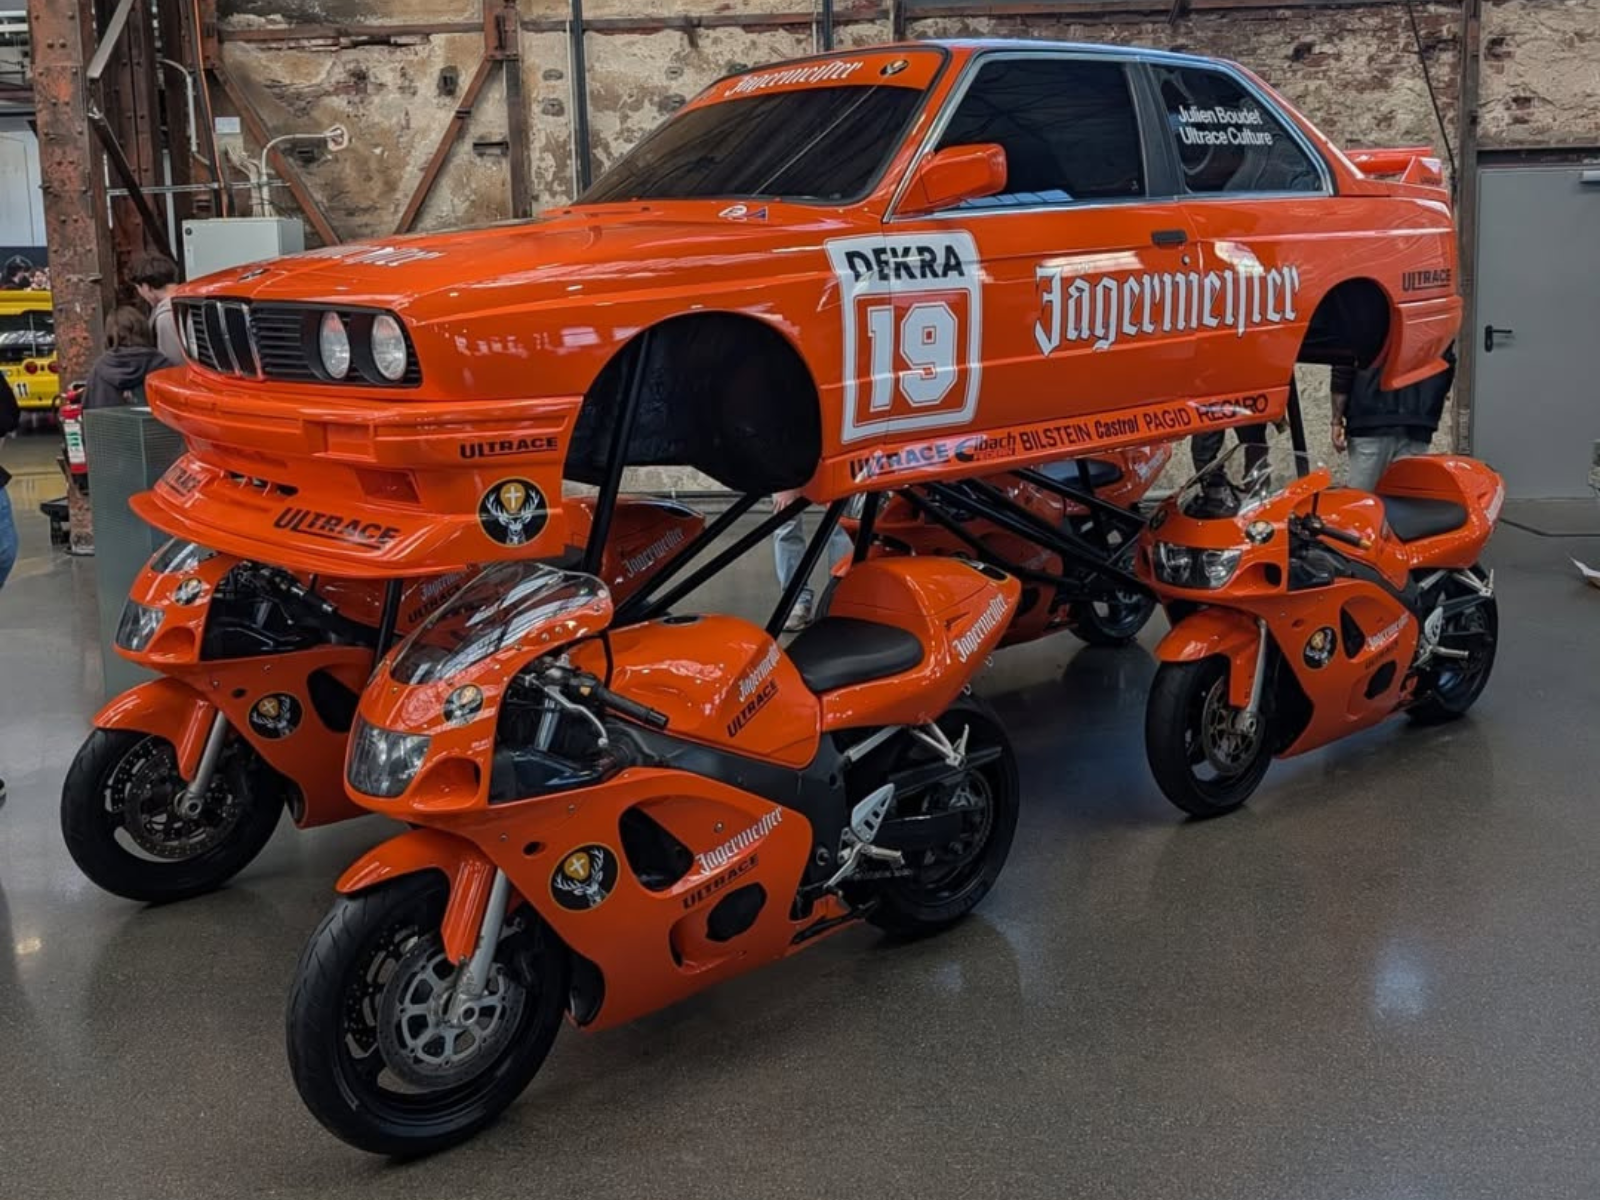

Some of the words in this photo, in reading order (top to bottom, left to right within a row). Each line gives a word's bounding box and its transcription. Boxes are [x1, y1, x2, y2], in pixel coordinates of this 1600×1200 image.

[1178, 105, 1216, 123] Julien
[1215, 106, 1263, 125] Boudet
[1179, 127, 1227, 145] Ultrace
[1227, 127, 1273, 145] Culture
[845, 245, 965, 283] DEKRA
[1402, 268, 1451, 292] ULTRACE
[866, 301, 959, 413] 19
[15, 383, 28, 397] 11
[460, 437, 558, 459] ULTRACE
[850, 441, 949, 481] ULTRACE
[1020, 425, 1091, 451] BILSTEIN
[1094, 416, 1139, 439] Castrol
[1143, 407, 1192, 431] PAGID
[1197, 393, 1269, 424] RECARO
[273, 506, 401, 550] ULTRACE
[726, 678, 779, 738] ULTRACE
